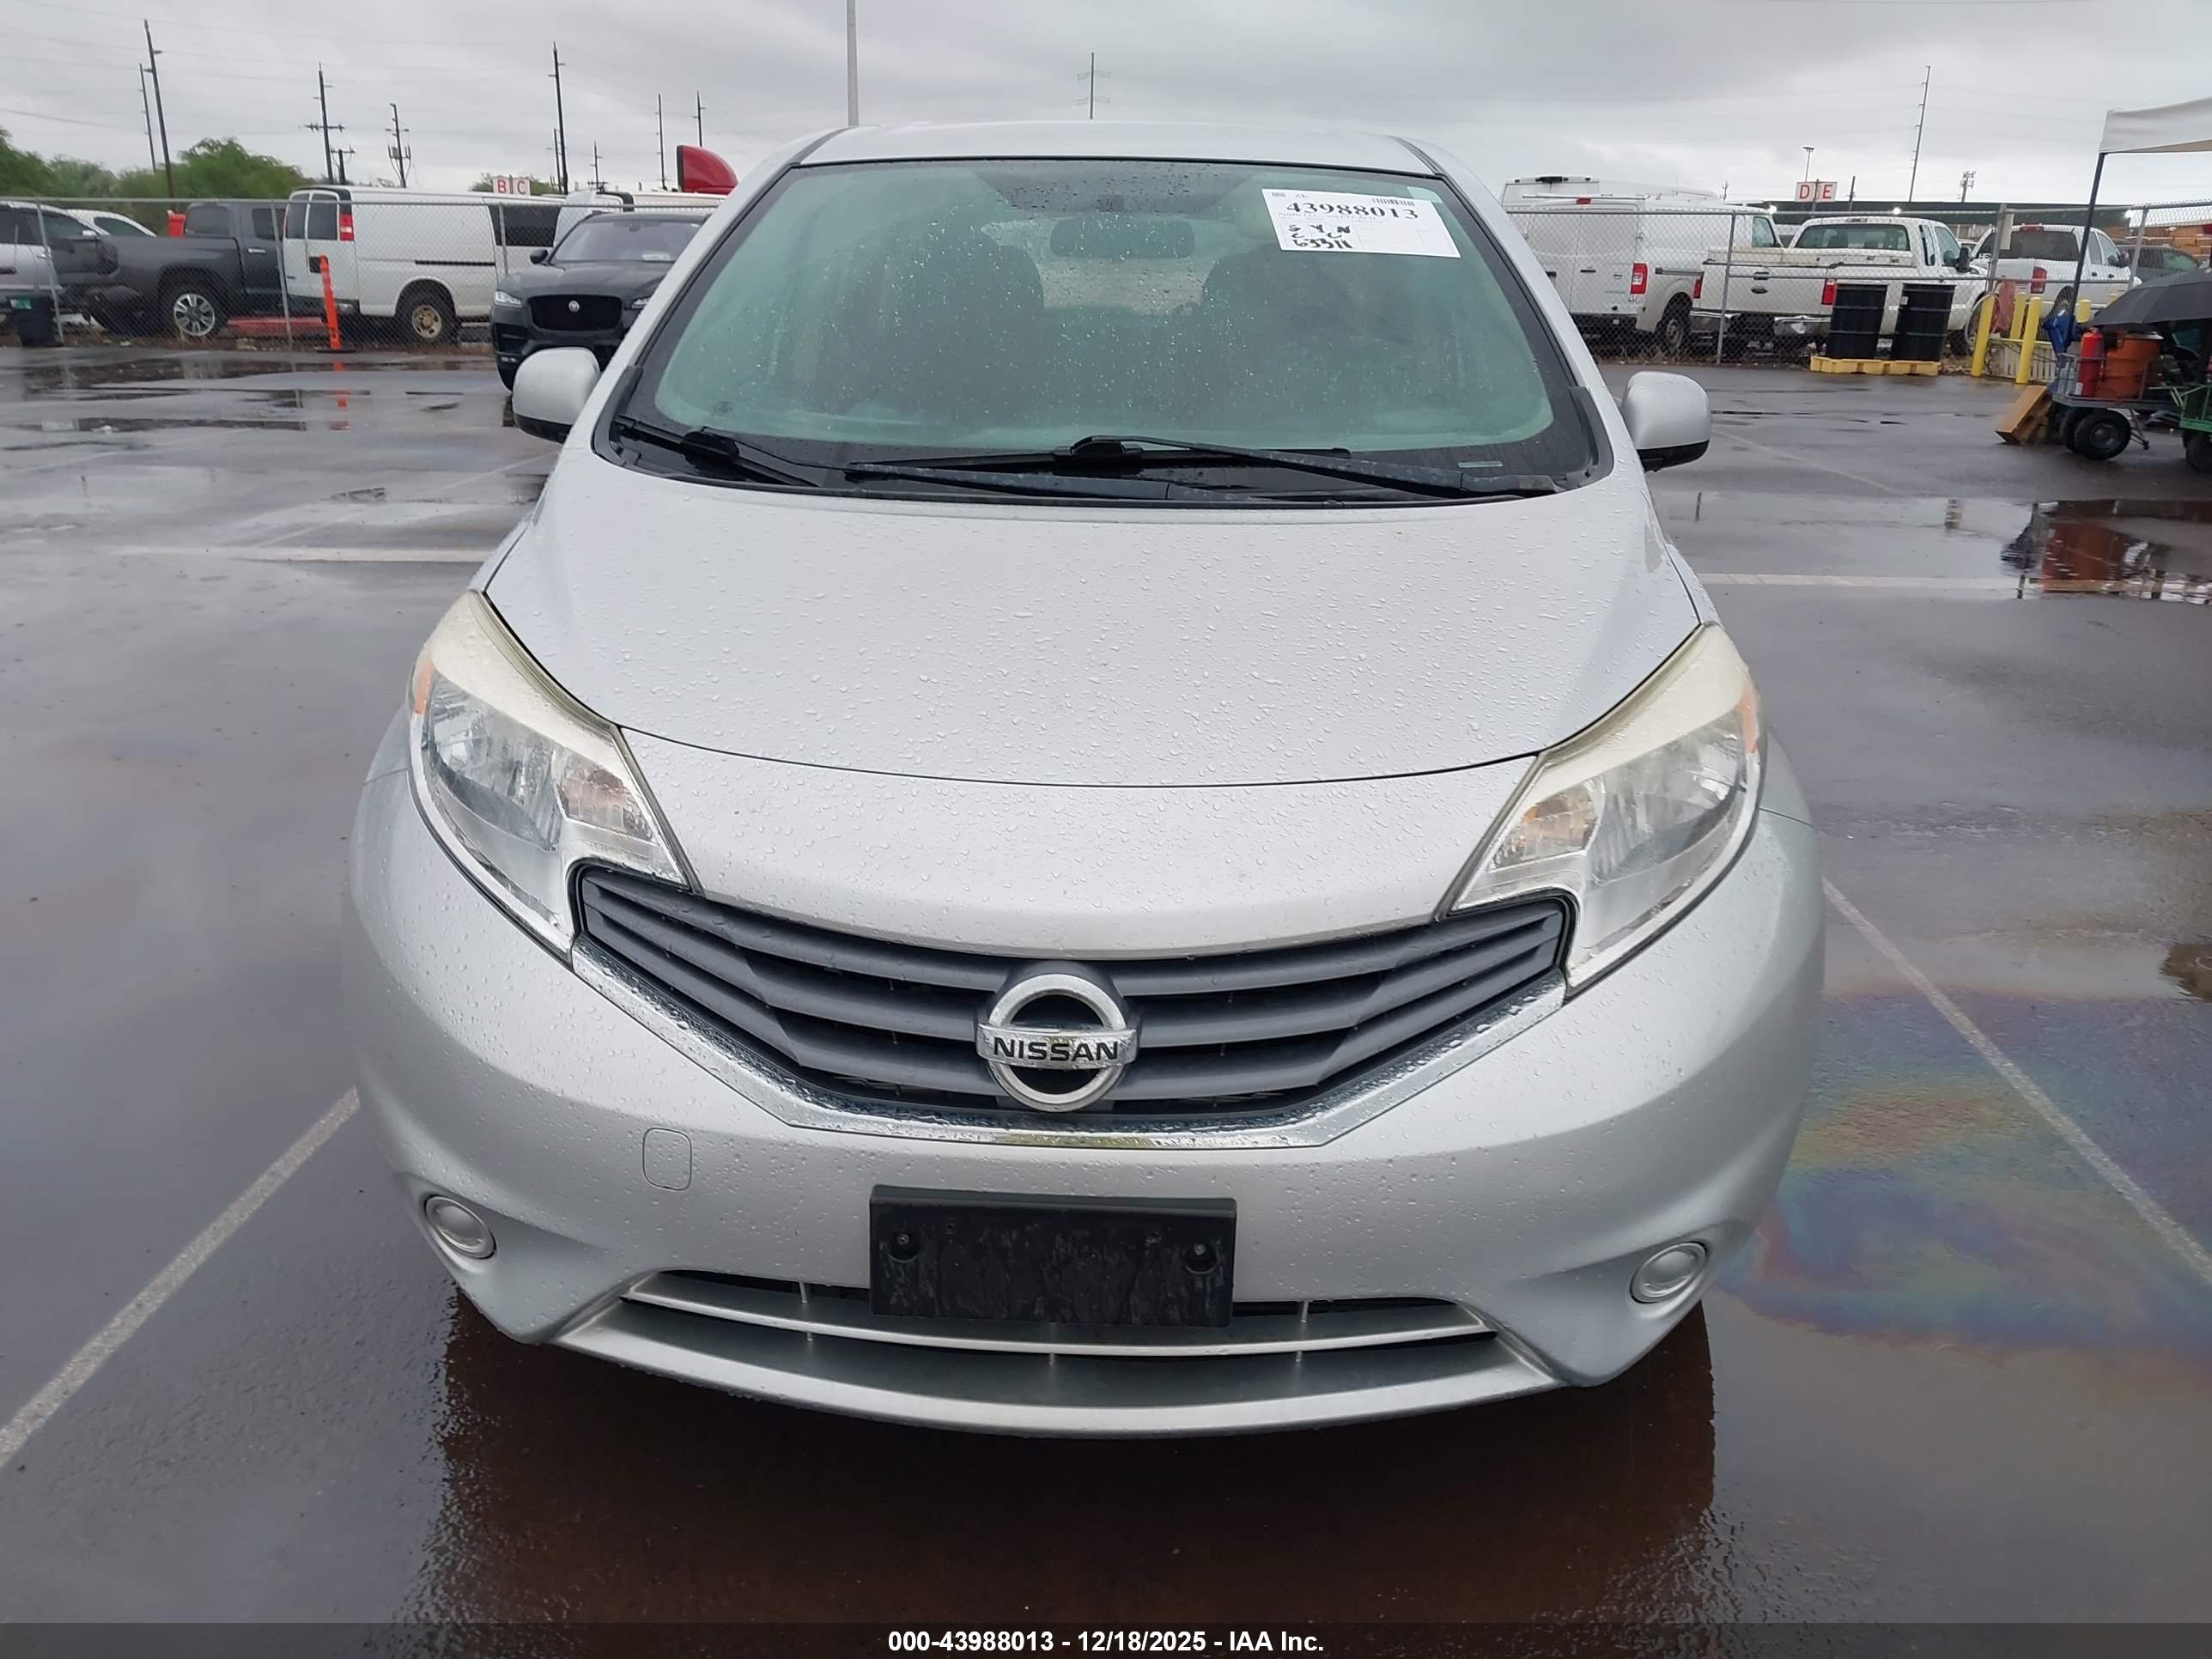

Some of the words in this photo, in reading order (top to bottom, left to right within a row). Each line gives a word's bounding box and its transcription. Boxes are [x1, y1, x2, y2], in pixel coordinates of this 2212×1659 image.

[498, 179, 507, 193] B
[517, 180, 526, 195] C
[1799, 184, 1810, 199] D
[1822, 184, 1833, 199] E
[1286, 201, 1419, 220] 43988013
[994, 1036, 1118, 1061] NISSAN
